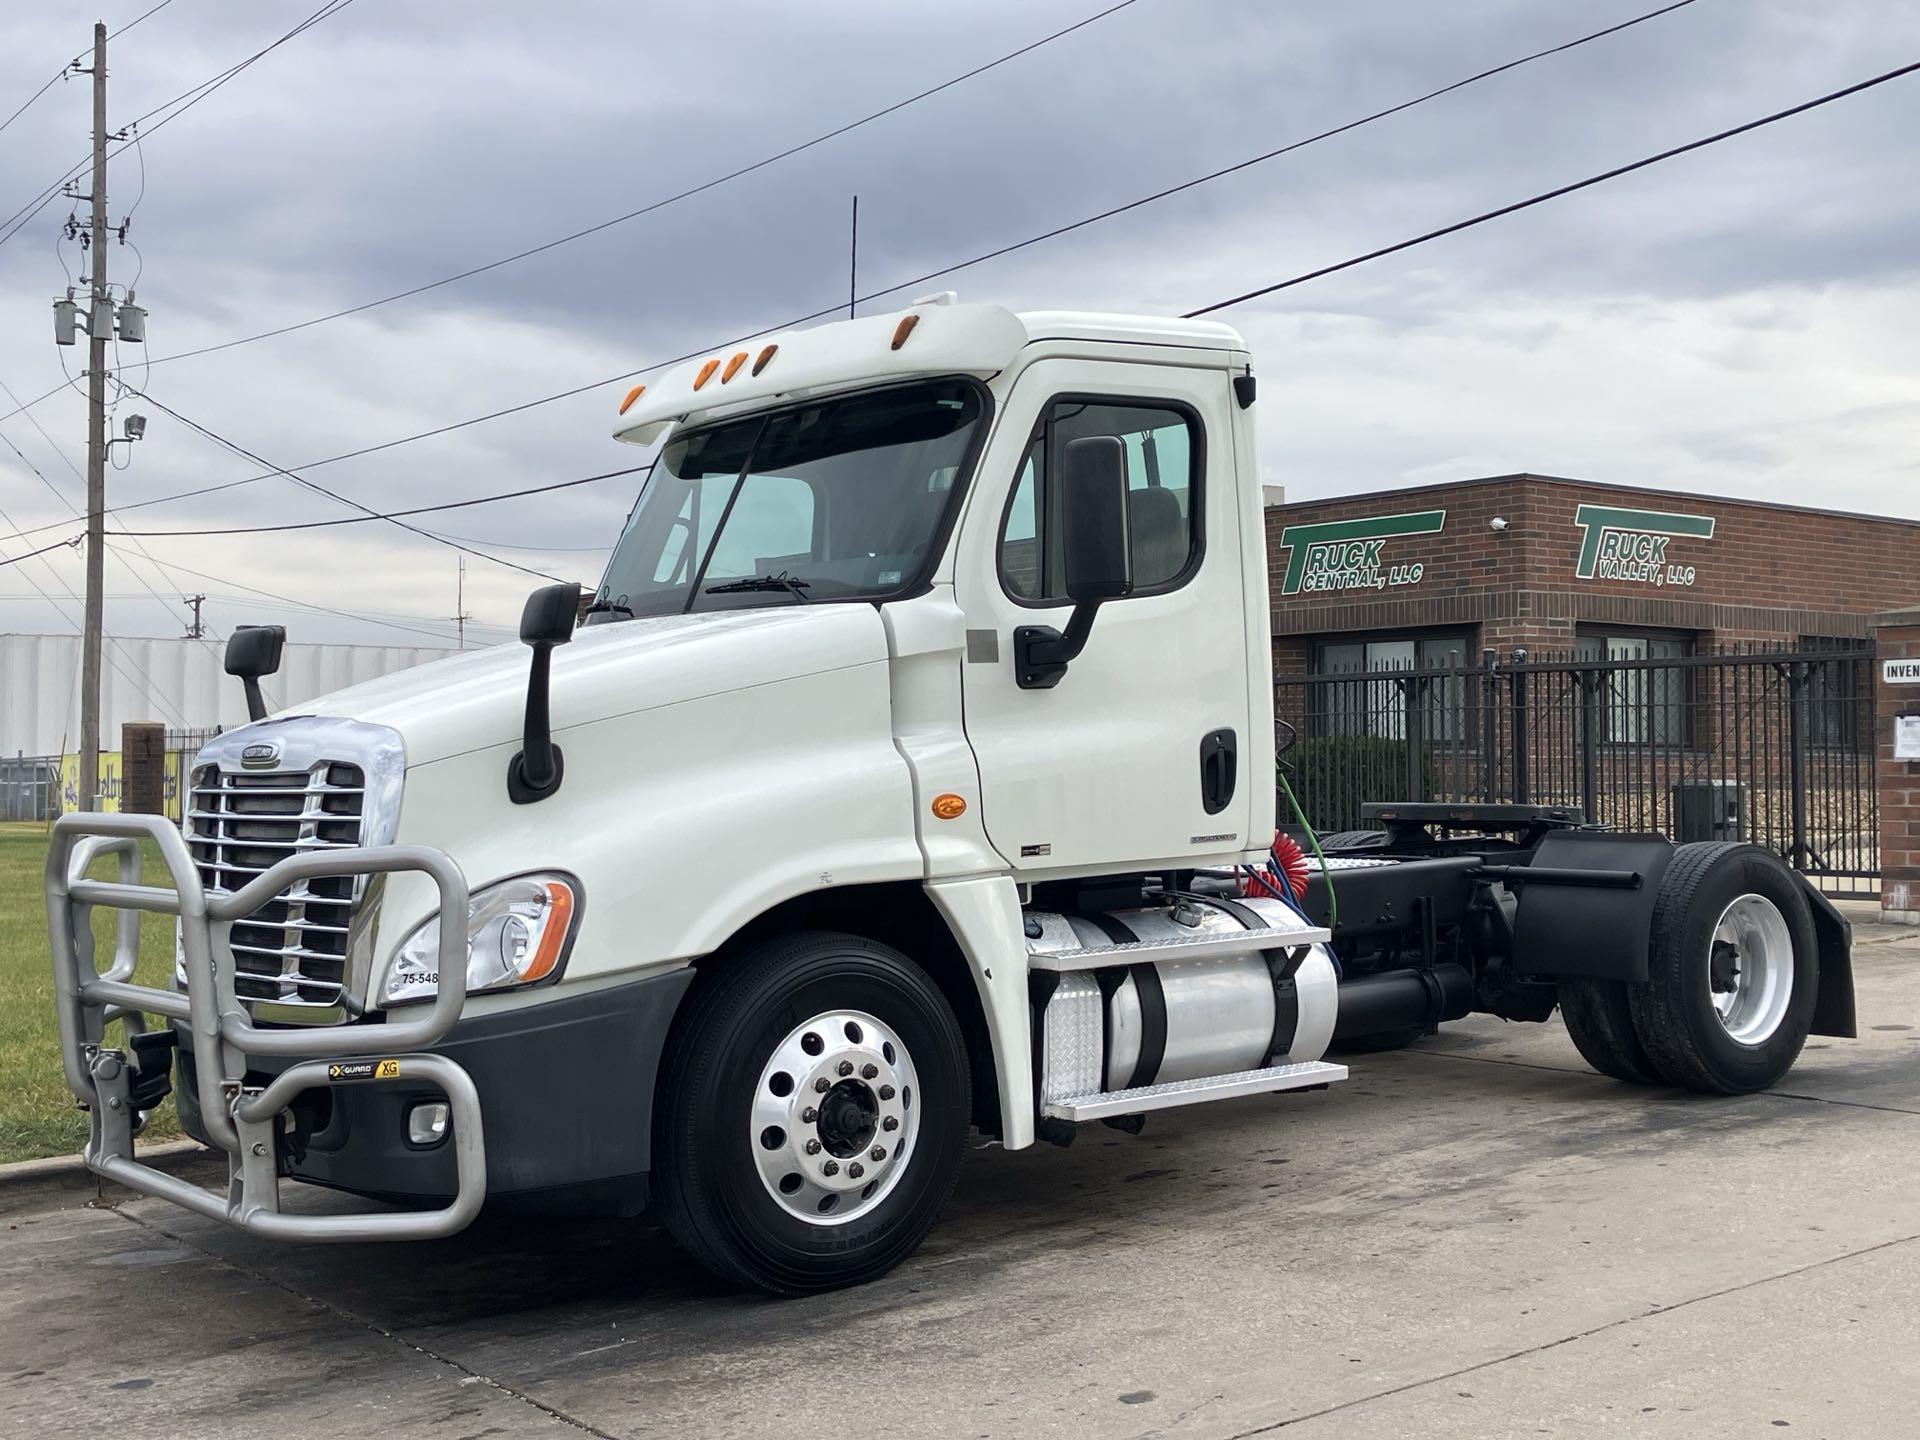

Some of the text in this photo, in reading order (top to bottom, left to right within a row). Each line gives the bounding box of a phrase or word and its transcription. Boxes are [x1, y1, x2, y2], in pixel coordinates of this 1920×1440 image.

[1280, 510, 1446, 595] TRUCK
[1575, 504, 1715, 579] TRUCK
[1302, 563, 1423, 593] CENTRAL, LLC
[1599, 559, 1696, 587] VALLEY, LLC
[1887, 665, 1920, 678] INVEN
[402, 972, 439, 984] 75-548
[382, 1061, 398, 1073] XG
